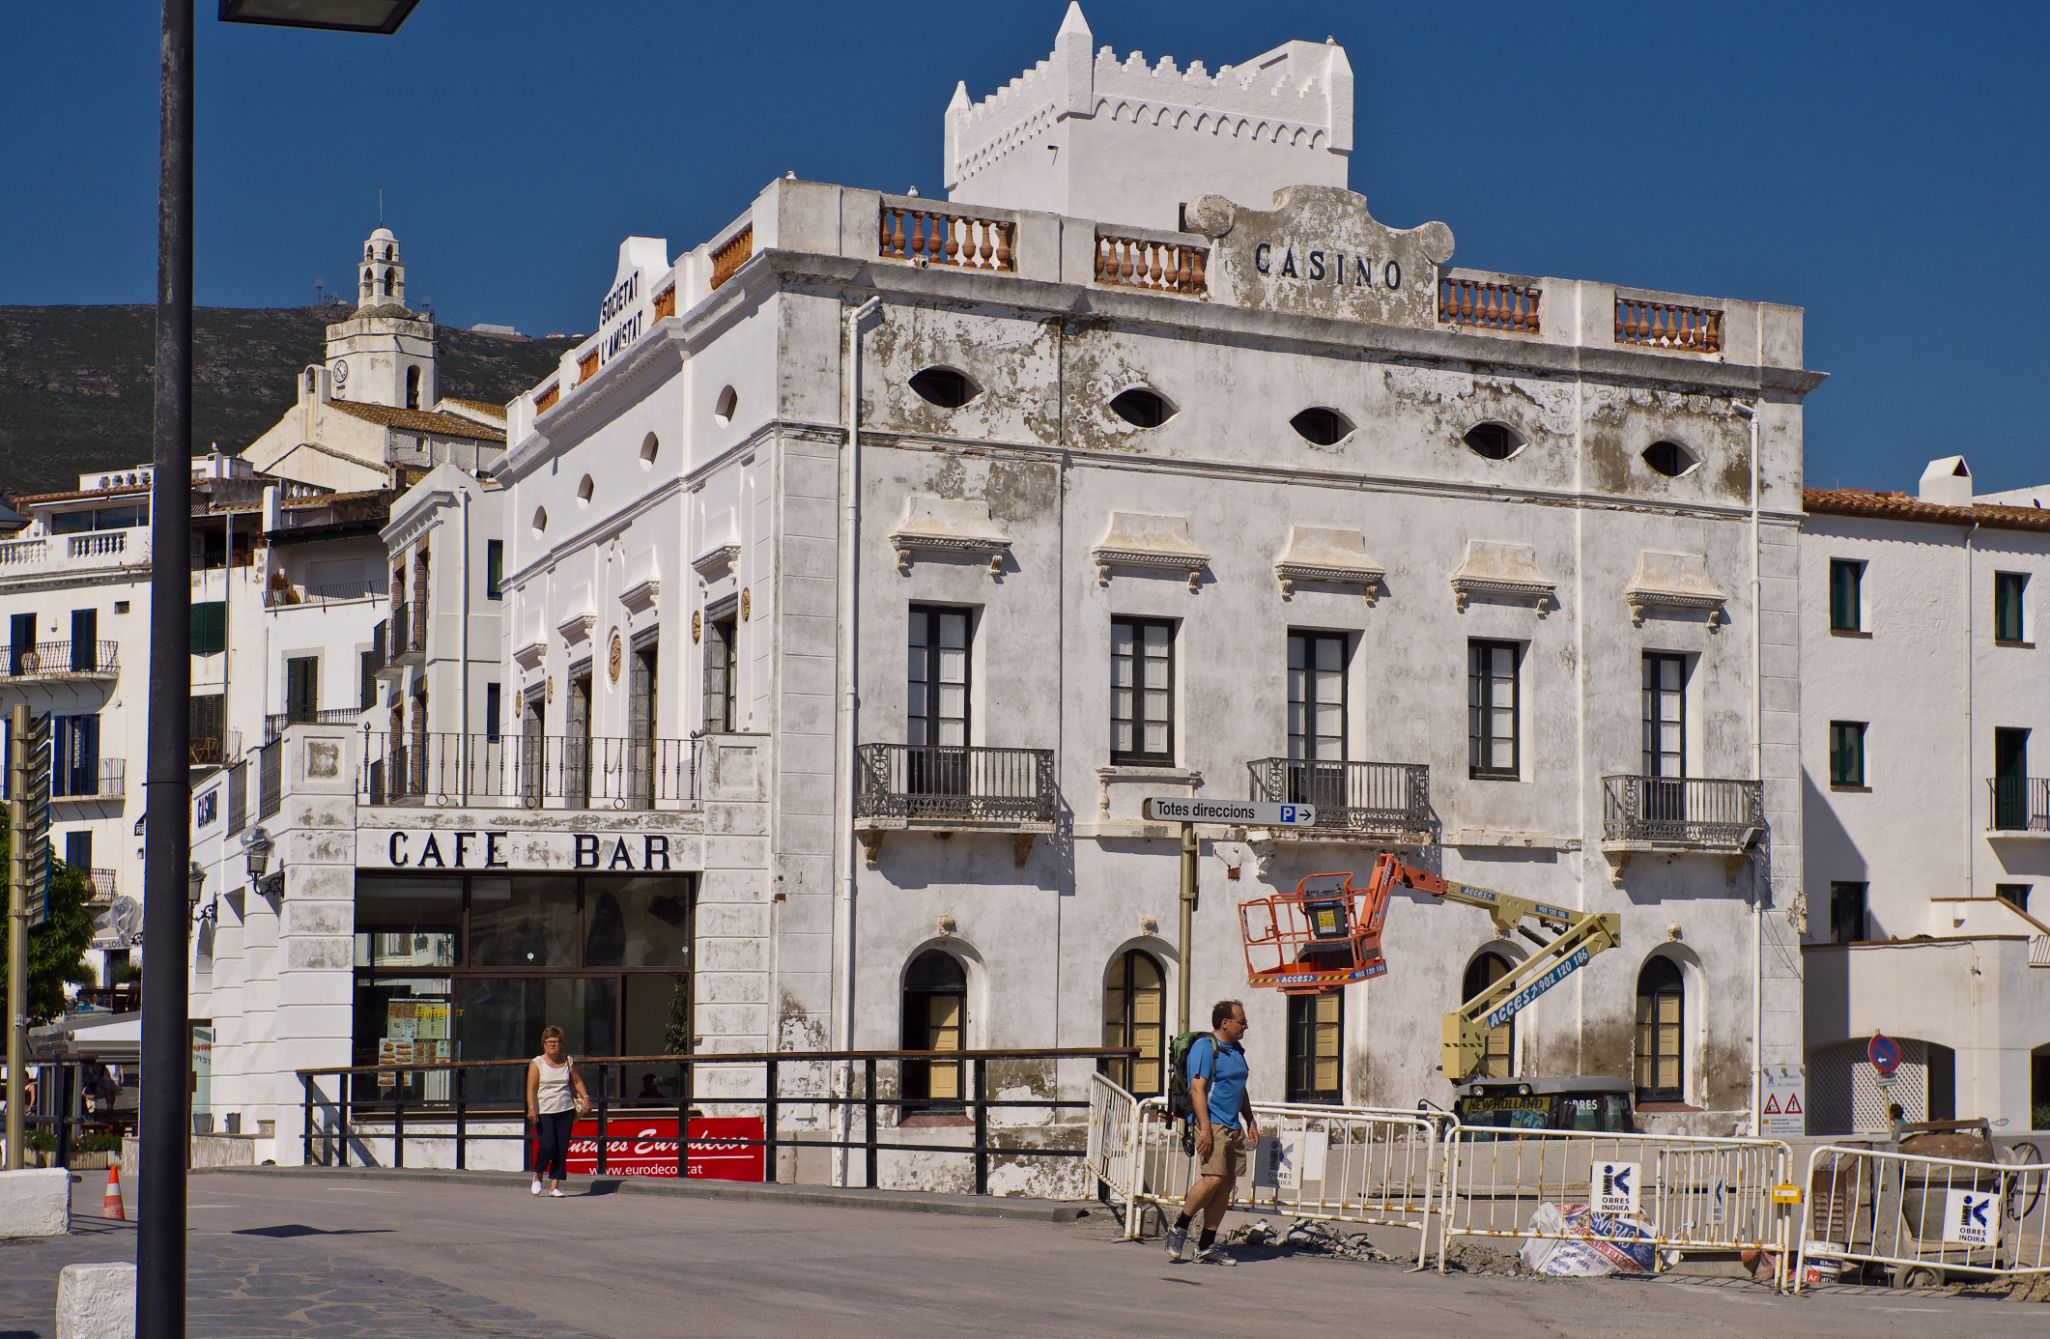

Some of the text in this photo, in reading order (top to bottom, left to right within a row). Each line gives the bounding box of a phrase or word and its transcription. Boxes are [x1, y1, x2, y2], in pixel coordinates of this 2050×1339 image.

[1255, 242, 1401, 290] CASINO
[1156, 801, 1189, 816] Totes
[1192, 802, 1255, 819] direccions
[389, 831, 670, 870] CAFE BAR
[1539, 971, 1556, 992] 902
[1556, 960, 1572, 979] 120
[1573, 949, 1588, 967] 186
[1601, 1204, 1630, 1212] INDIKA
[1958, 1234, 1986, 1243] INDIKA
[1959, 1227, 1987, 1236] OBRES
